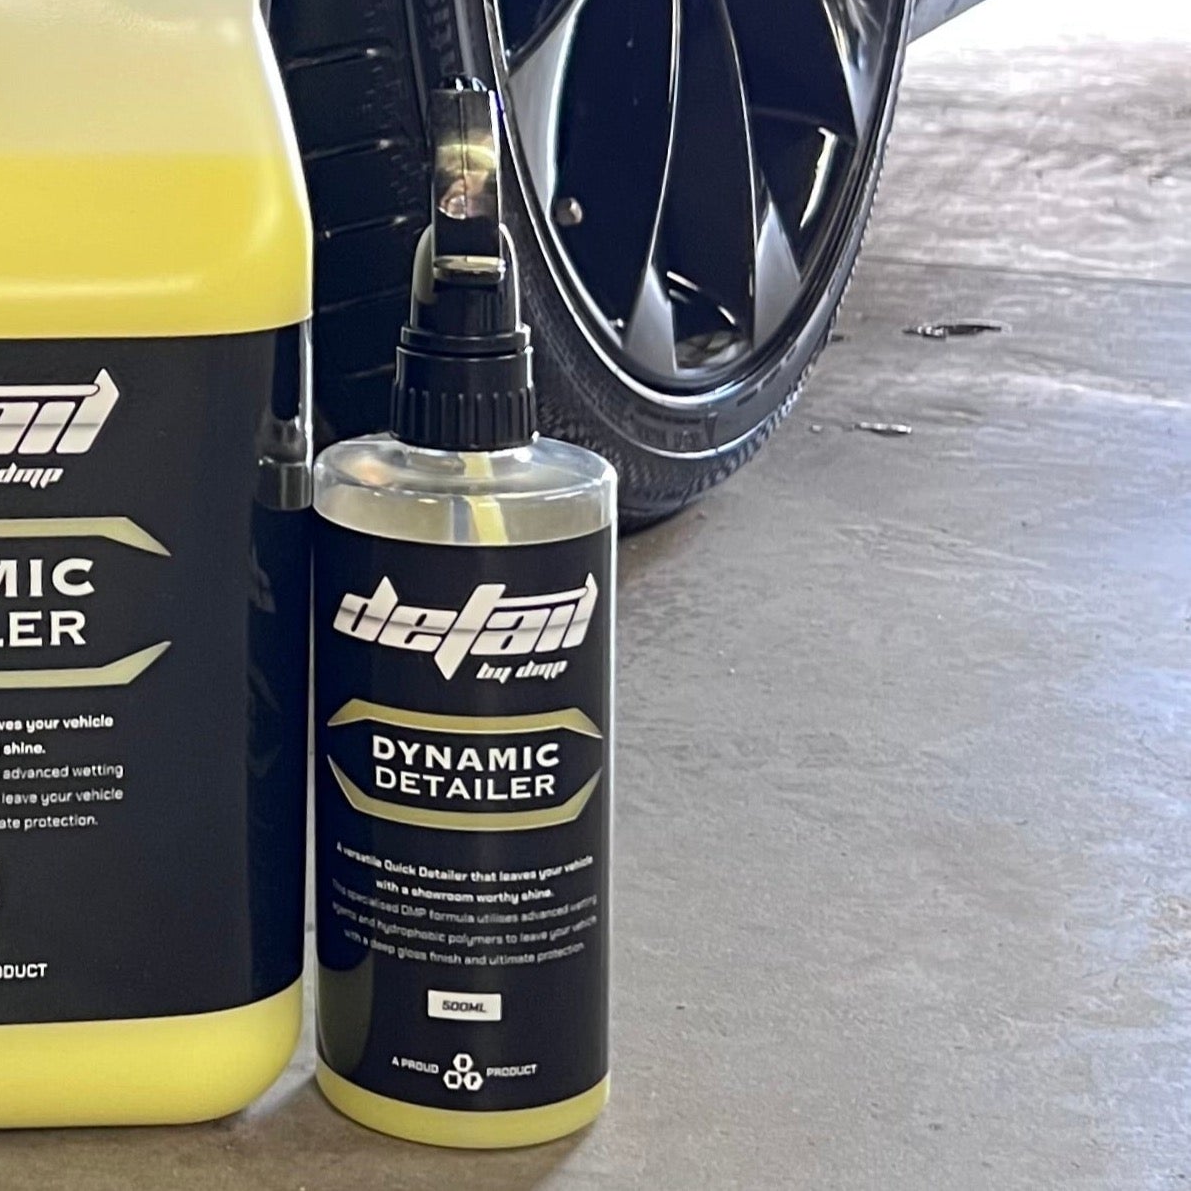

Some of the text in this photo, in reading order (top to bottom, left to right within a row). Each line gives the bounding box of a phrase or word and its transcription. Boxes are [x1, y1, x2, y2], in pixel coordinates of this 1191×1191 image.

[332, 572, 599, 681] detail
[477, 663, 512, 683] by
[26, 720, 59, 733] your
[63, 714, 113, 728] vehicle
[4, 742, 45, 755] shine.
[372, 734, 560, 772] DYNAMIC
[3, 766, 69, 779] advanced
[72, 765, 123, 778] wetting
[375, 765, 555, 800] DETAILER
[2, 793, 37, 804] leave
[41, 792, 72, 806] your
[76, 788, 123, 801] vehicle
[24, 815, 97, 830] protection.
[384, 860, 416, 875] Quick
[419, 866, 467, 881] Detailer
[471, 872, 496, 882] that
[500, 871, 536, 881] leaves
[539, 866, 562, 880] your
[412, 887, 474, 902] showroom
[477, 892, 519, 904] worthy
[442, 1000, 488, 1014] 500ML
[392, 1057, 439, 1074] A PROUD
[486, 1064, 537, 1076] PRODUCT
